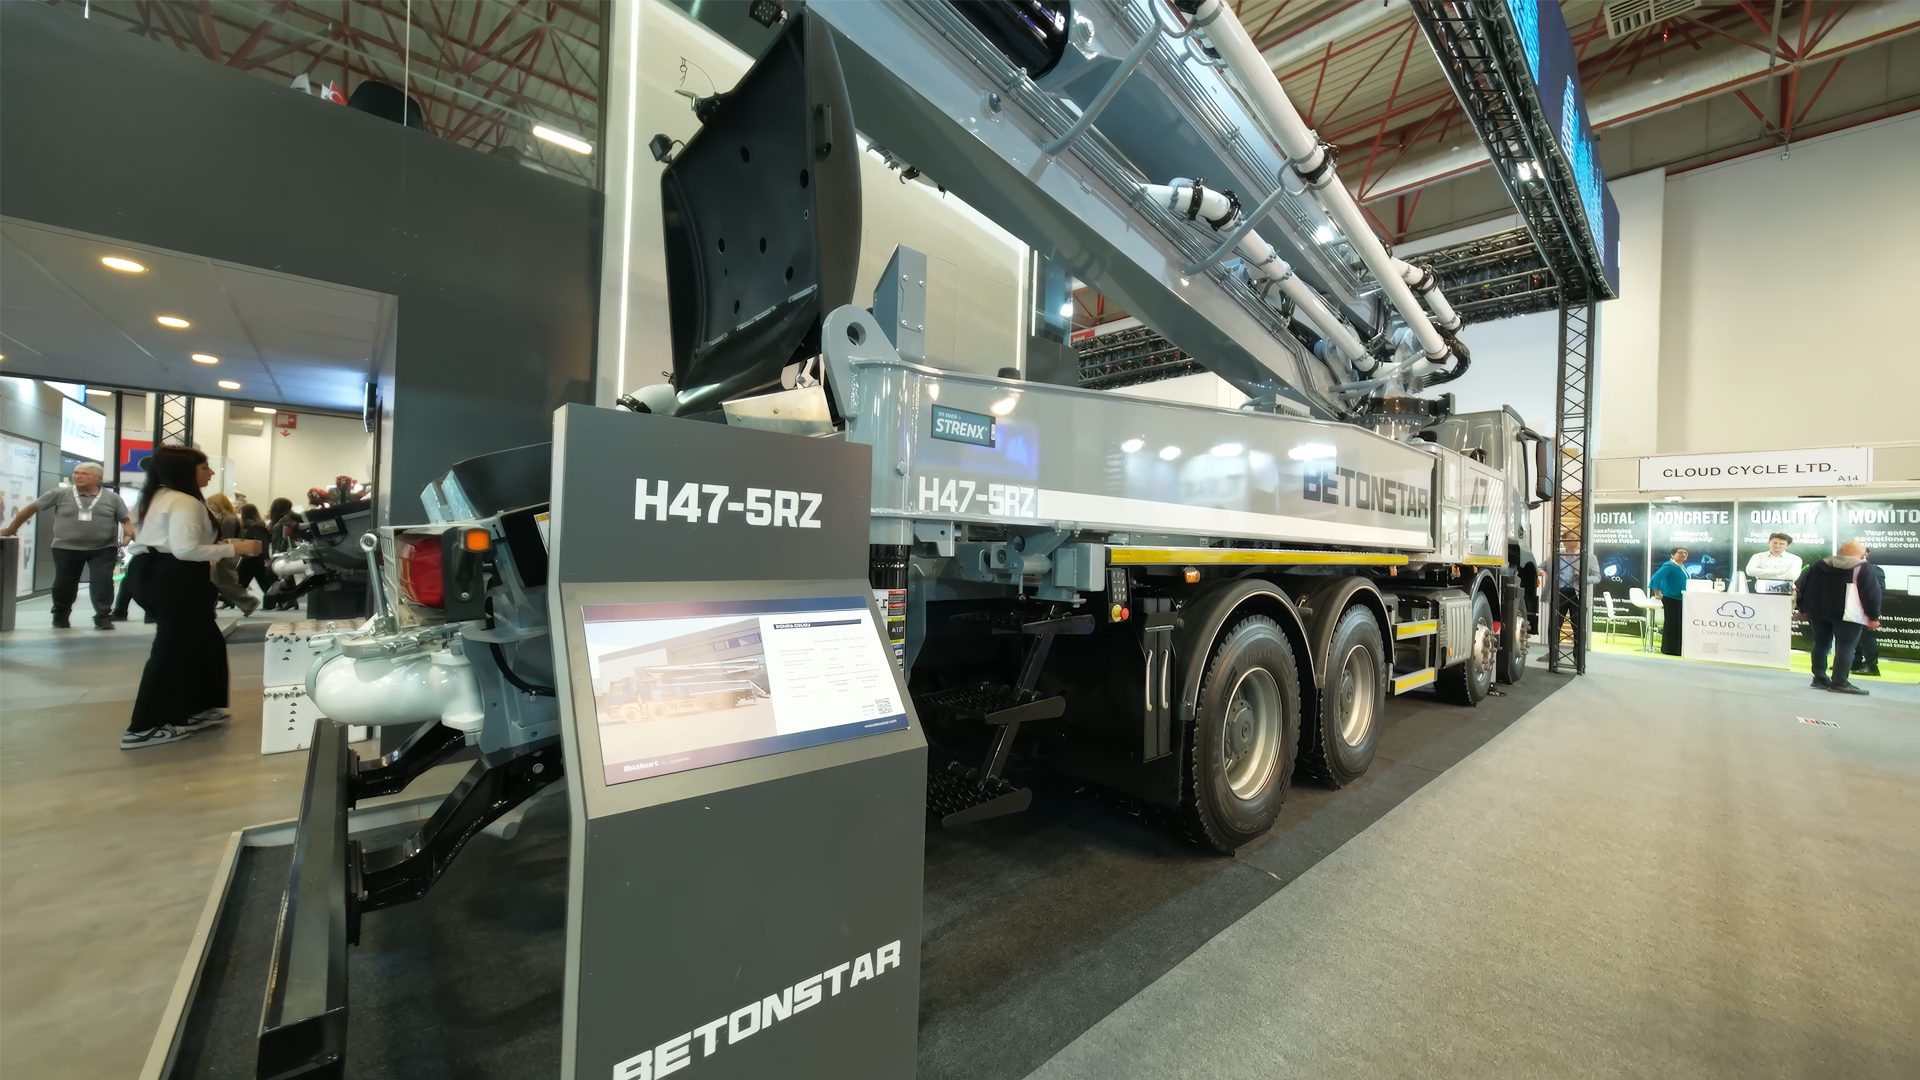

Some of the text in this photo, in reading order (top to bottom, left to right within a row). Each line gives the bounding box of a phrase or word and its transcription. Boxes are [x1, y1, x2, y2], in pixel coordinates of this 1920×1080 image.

[1303, 460, 1428, 519] BETONSTAR
[1663, 462, 1837, 478] CLOUD CYCLE LTD.
[635, 478, 823, 528] H47-5RZ
[919, 476, 1035, 517] H47-5RZ
[1750, 509, 1819, 524] QUALITY
[1655, 510, 1729, 525] CONCRETE
[613, 939, 901, 1080] BETONSTAR
